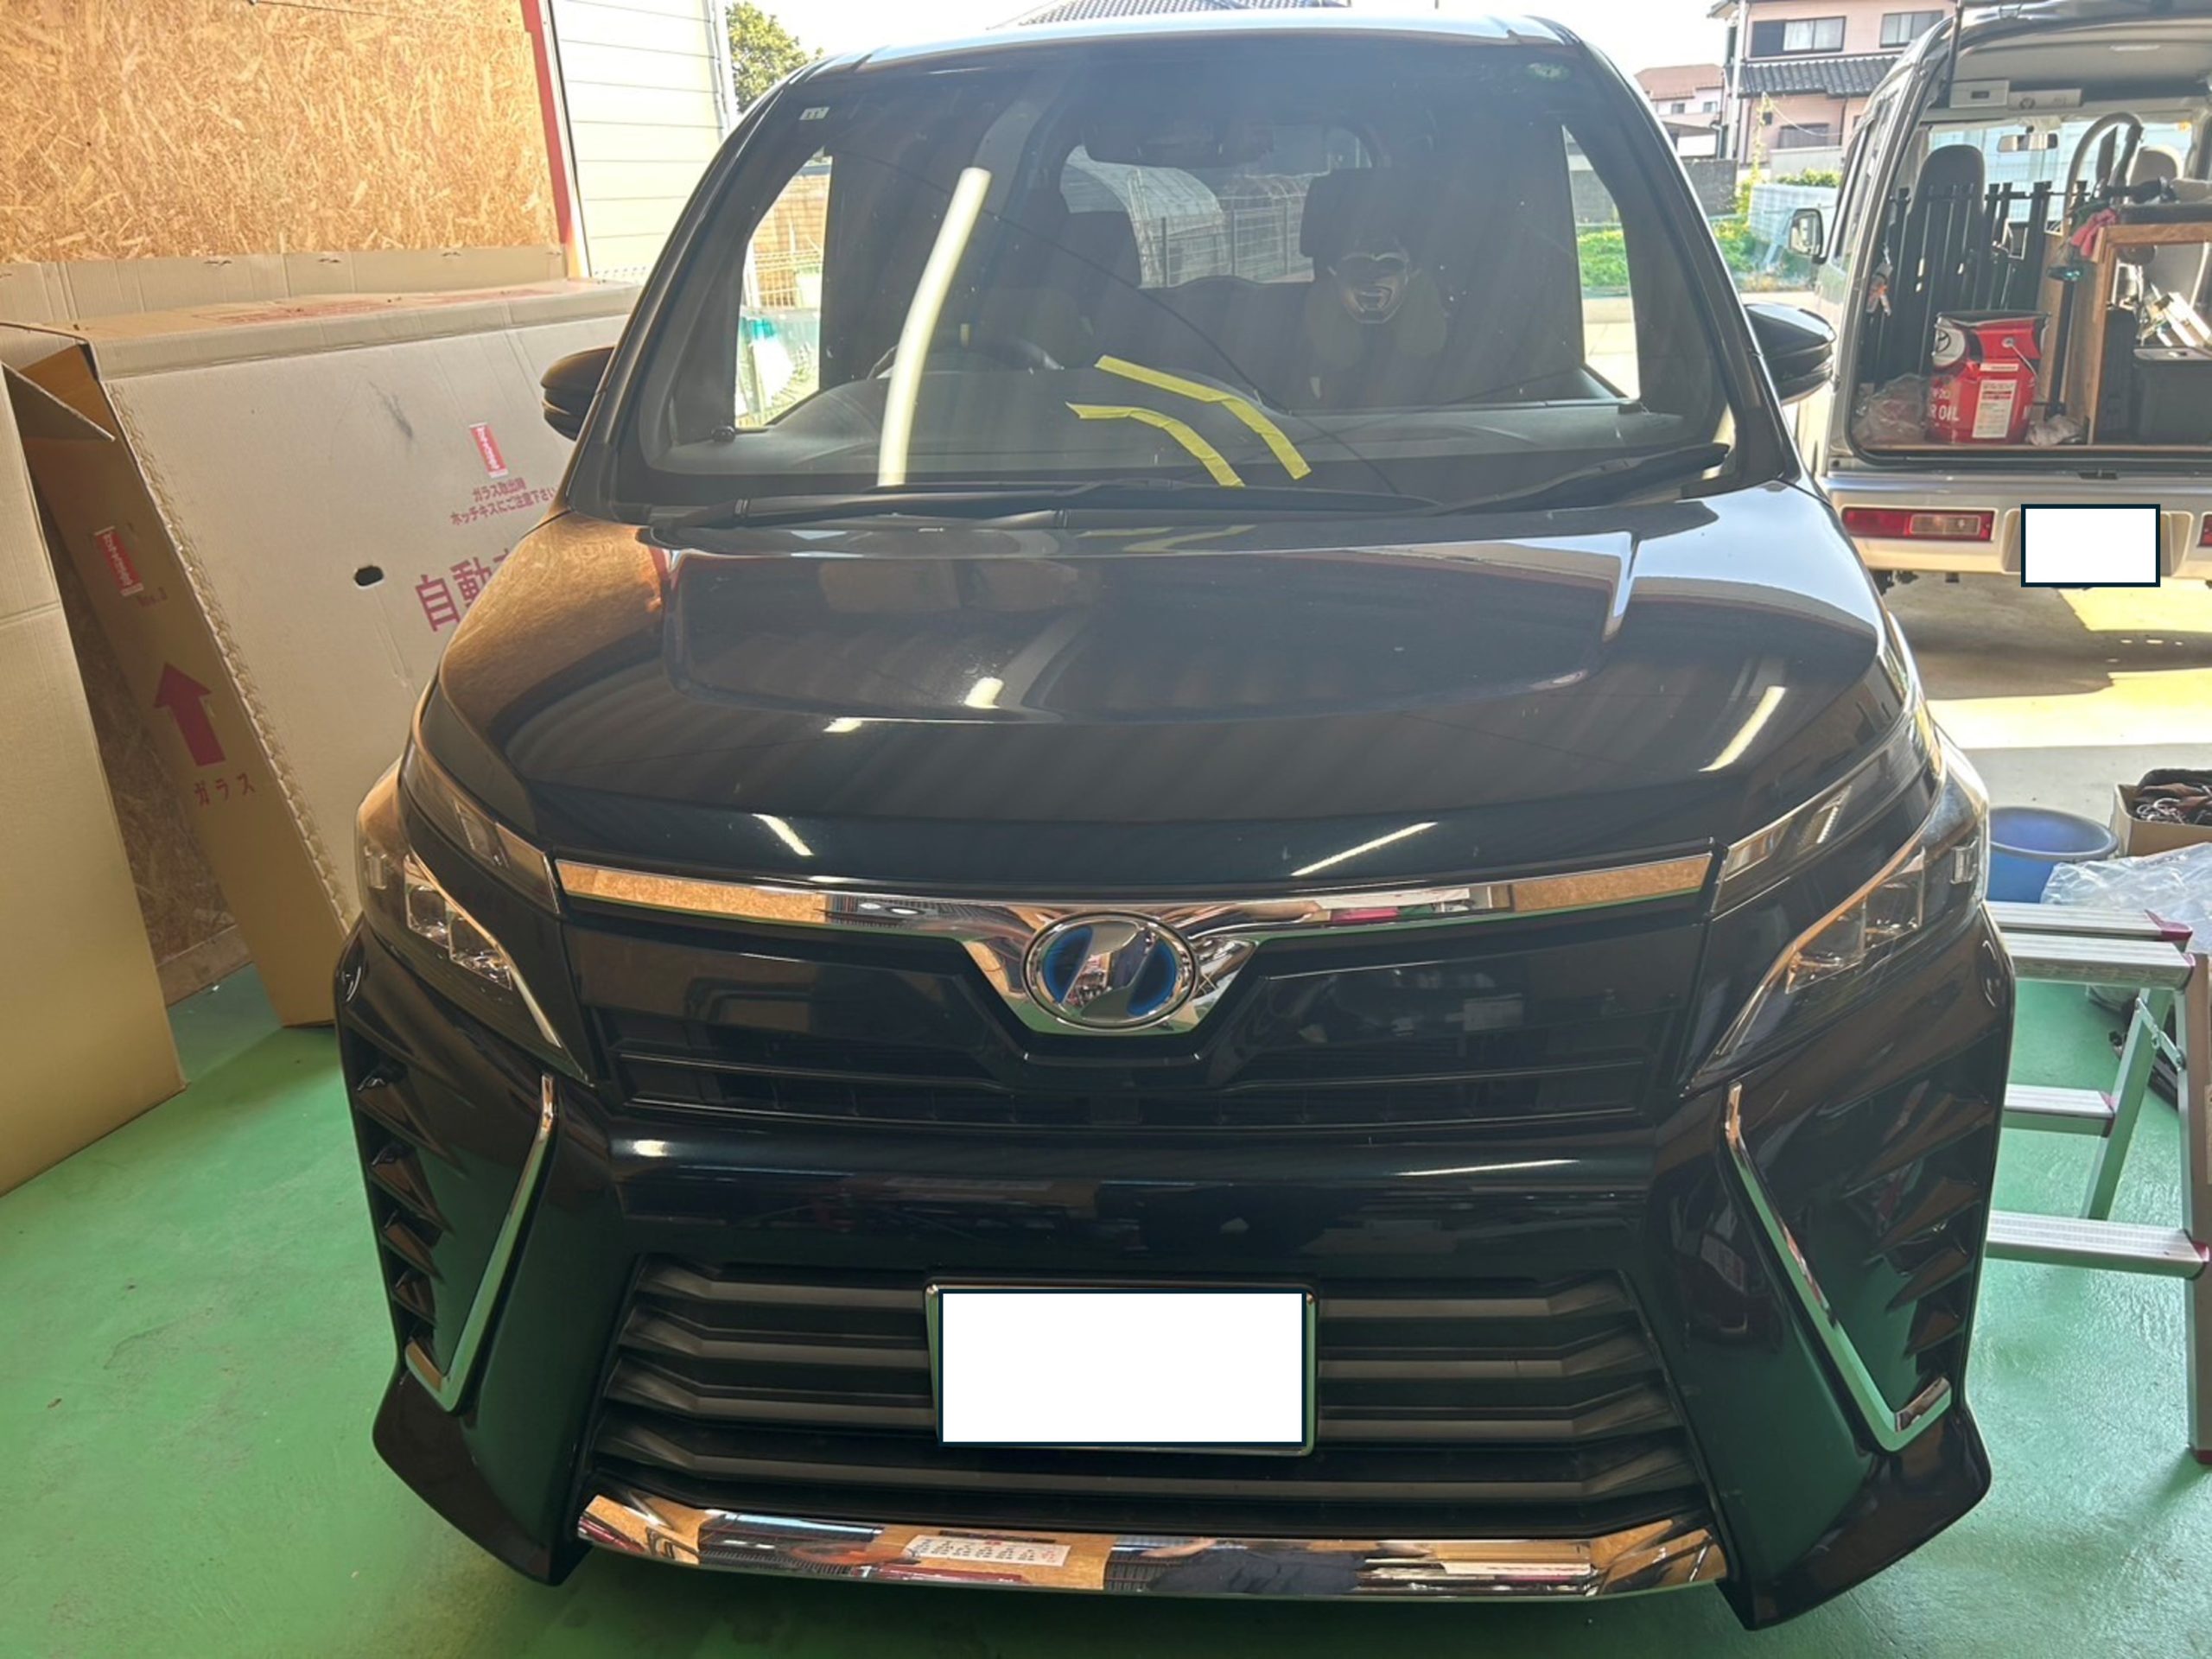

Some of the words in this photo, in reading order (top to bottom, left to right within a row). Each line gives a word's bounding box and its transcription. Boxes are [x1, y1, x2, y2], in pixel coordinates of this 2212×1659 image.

[415, 548, 510, 632] 自動
[194, 772, 256, 806] ガラス
